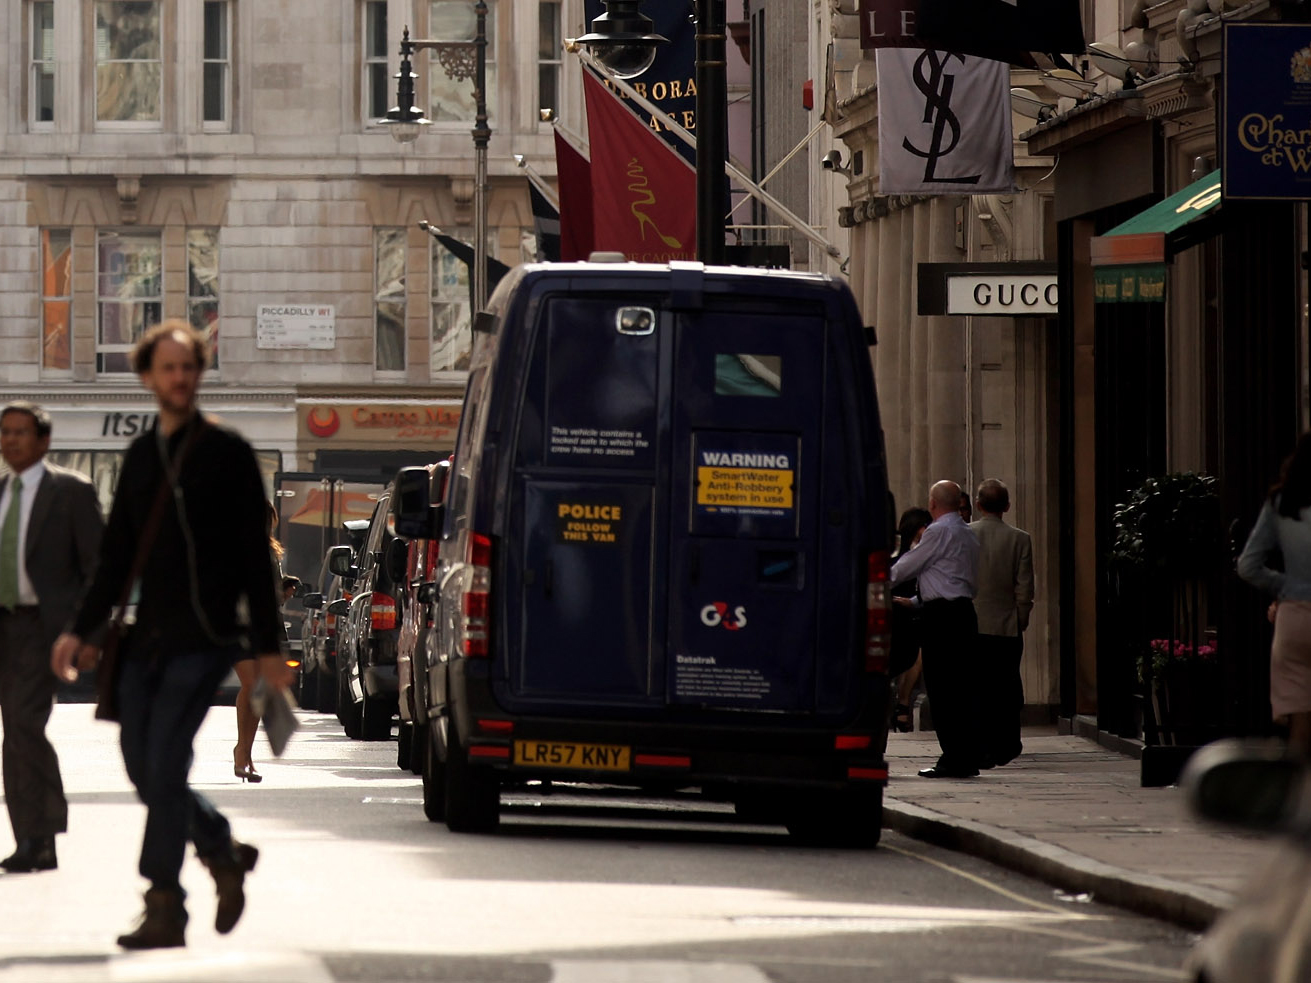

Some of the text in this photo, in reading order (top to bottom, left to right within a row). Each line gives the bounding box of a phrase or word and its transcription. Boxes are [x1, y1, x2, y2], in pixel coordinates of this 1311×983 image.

[1261, 147, 1284, 167] et
[262, 307, 331, 316] PICCADILLY W1
[551, 427, 568, 436] This
[570, 427, 598, 437] vehicle
[600, 428, 634, 438] contains
[599, 438, 607, 446] to
[609, 438, 633, 447] which
[635, 439, 649, 447] the
[702, 451, 789, 469] WARNING
[711, 471, 781, 482] SmartWater
[708, 482, 784, 494] Anti-Robbery
[706, 492, 747, 503] system
[750, 494, 761, 502] in
[558, 504, 621, 520] POLICE
[567, 522, 611, 532] FOLLOW
[563, 531, 615, 542] THIS VAN
[700, 602, 748, 630] G4S
[521, 743, 622, 767] LR57 KNY
